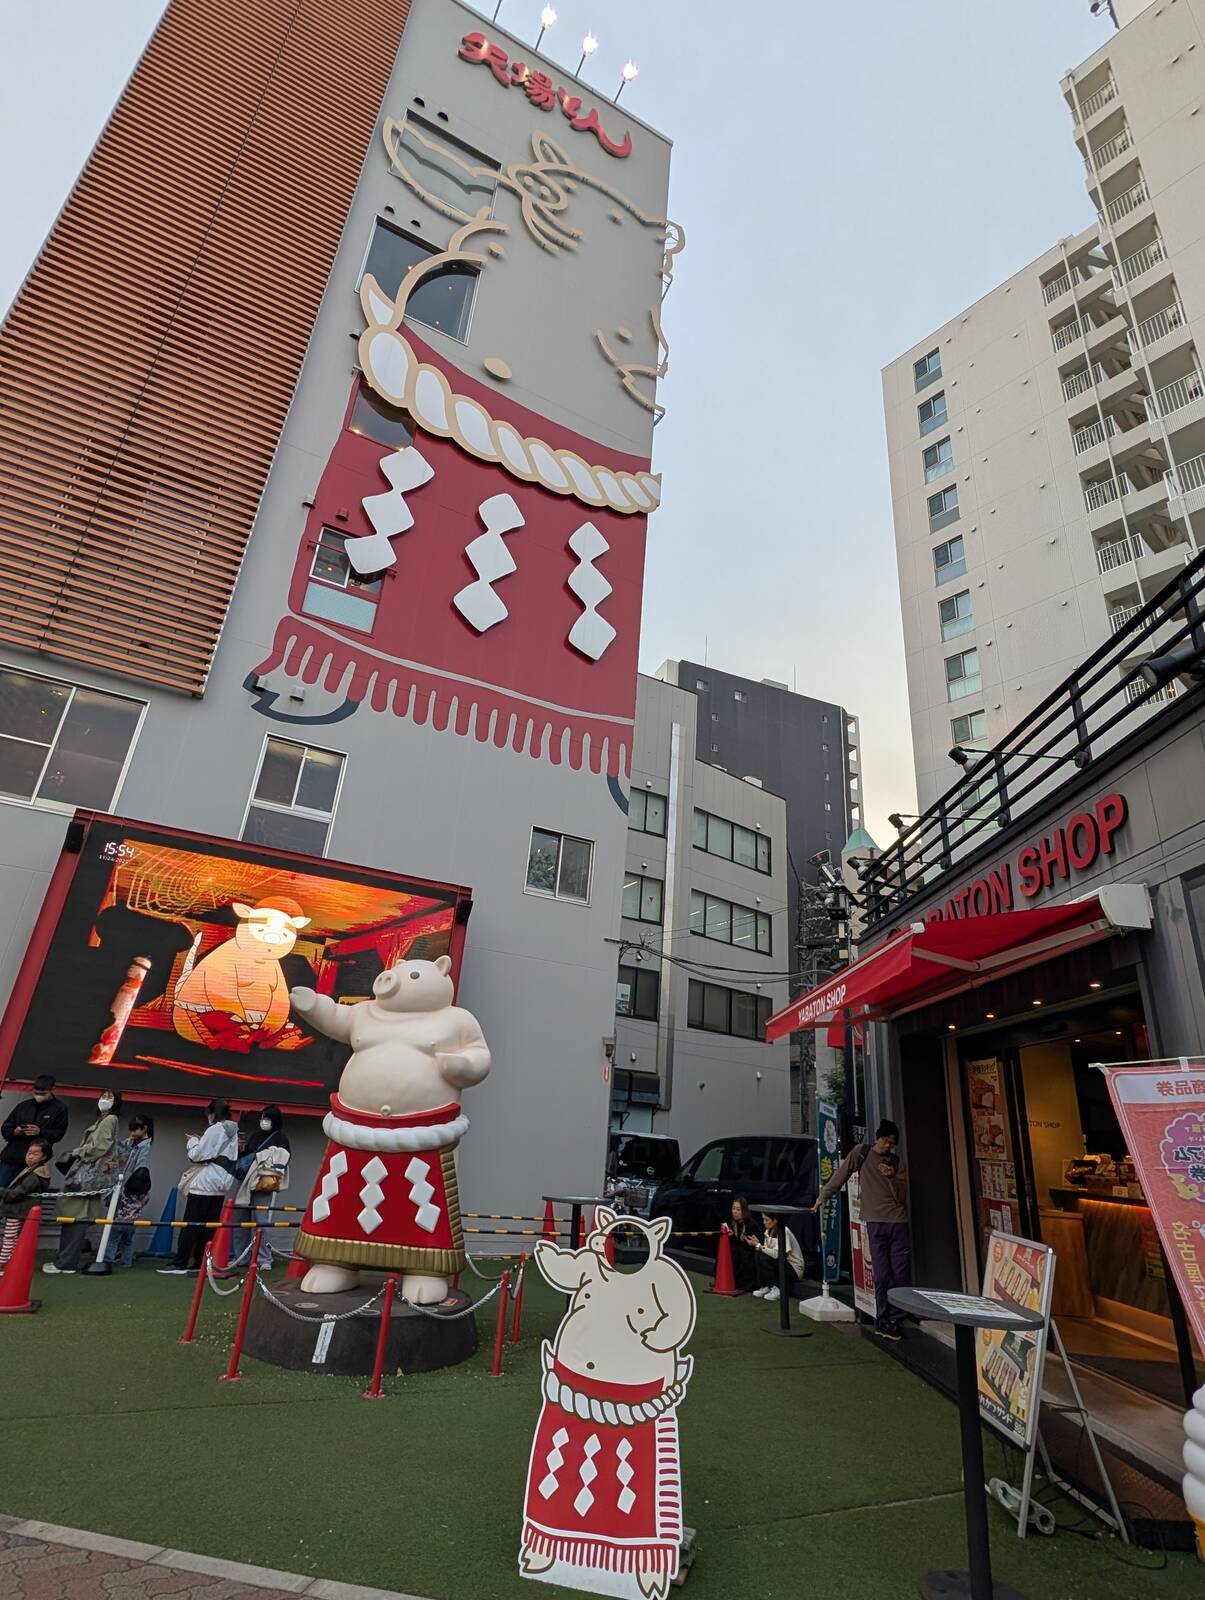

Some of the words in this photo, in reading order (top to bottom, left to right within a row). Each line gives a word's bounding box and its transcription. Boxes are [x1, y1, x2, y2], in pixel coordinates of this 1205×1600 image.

[104, 842, 135, 858] 15:54
[1017, 793, 1127, 897] SHOP
[798, 995, 826, 1024] YABATON
[826, 984, 846, 1010] SHOP
